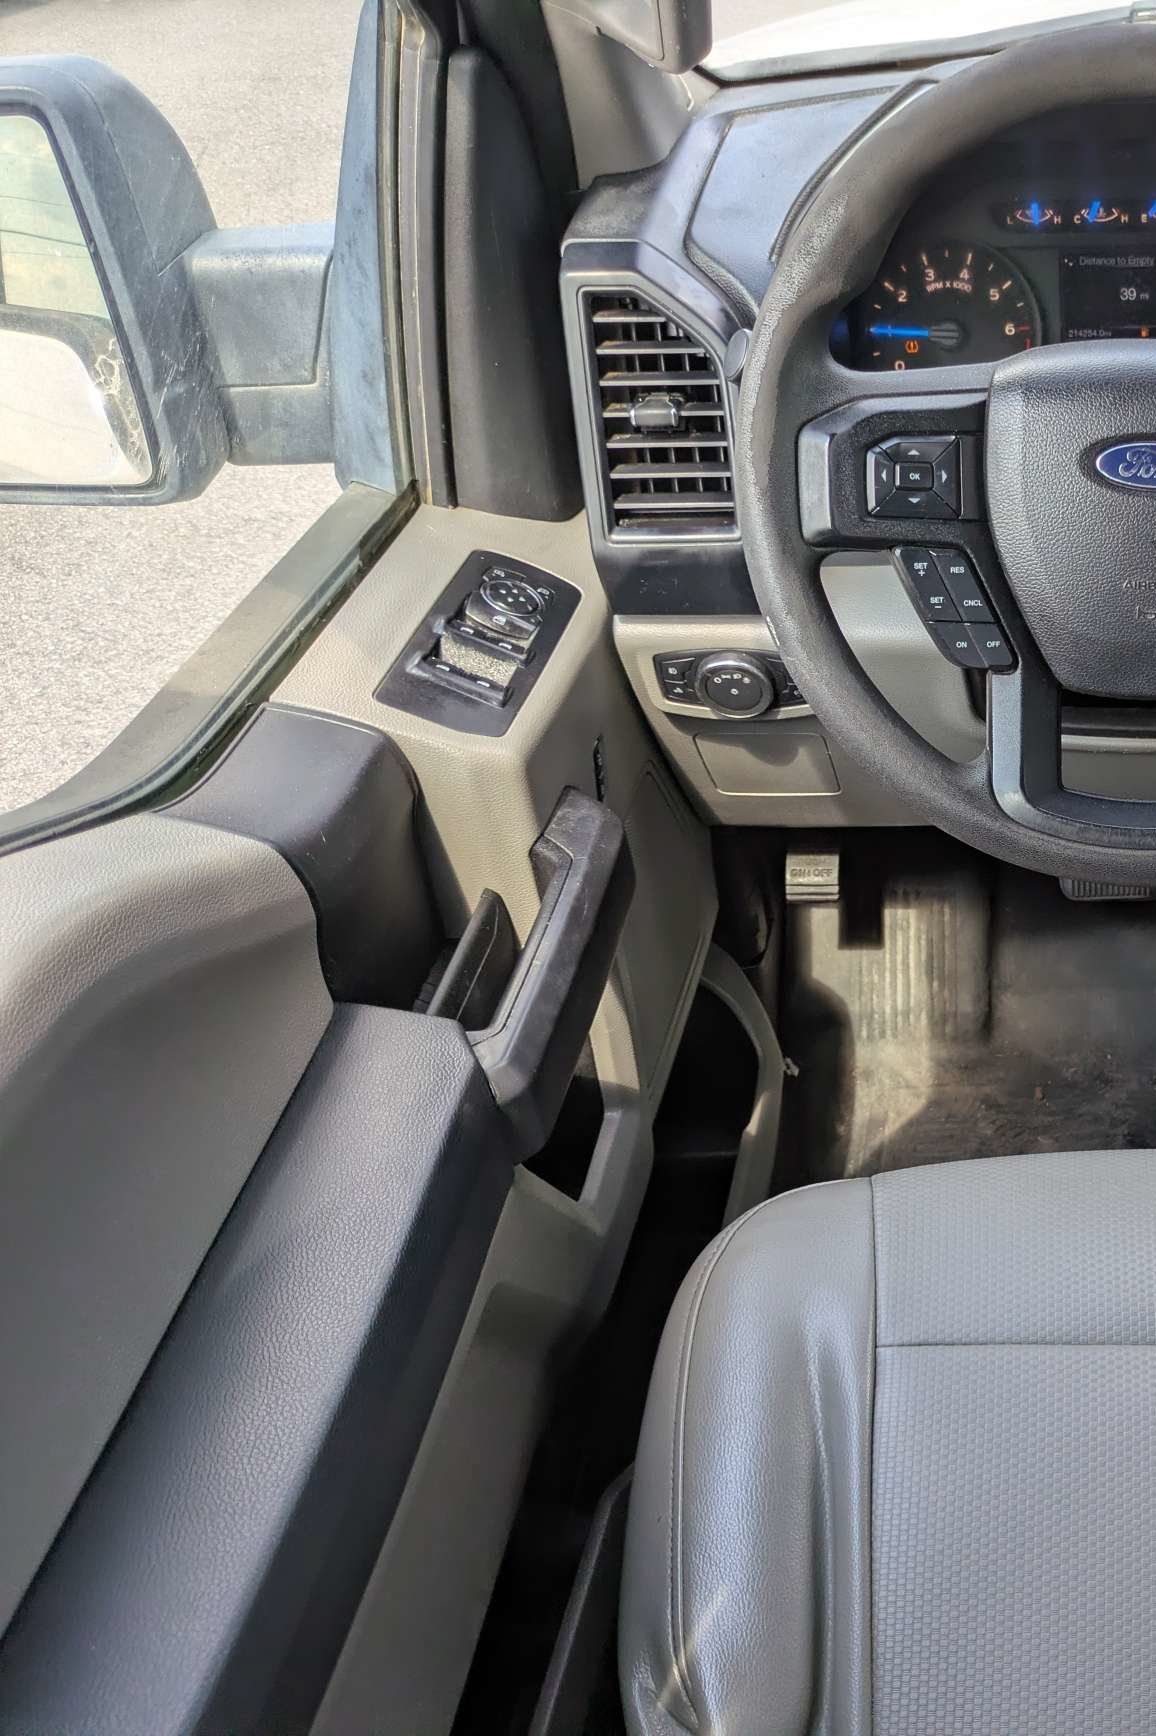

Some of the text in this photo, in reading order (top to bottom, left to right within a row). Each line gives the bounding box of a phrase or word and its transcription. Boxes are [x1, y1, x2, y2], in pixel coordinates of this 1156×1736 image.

[1007, 216, 1013, 224] L
[1054, 216, 1062, 224] H
[1074, 215, 1081, 224] C
[1121, 215, 1128, 224] H
[1141, 214, 1147, 222] E
[1079, 256, 1154, 267] Distance to Empty
[925, 269, 935, 281] 3
[960, 269, 970, 280] 4
[953, 281, 972, 293] 1000
[898, 290, 907, 302] 2
[990, 289, 1000, 300] 5
[1120, 288, 1137, 300] 39
[1004, 324, 1015, 336] 6
[895, 360, 905, 371] 0
[986, 640, 1000, 648] OFF
